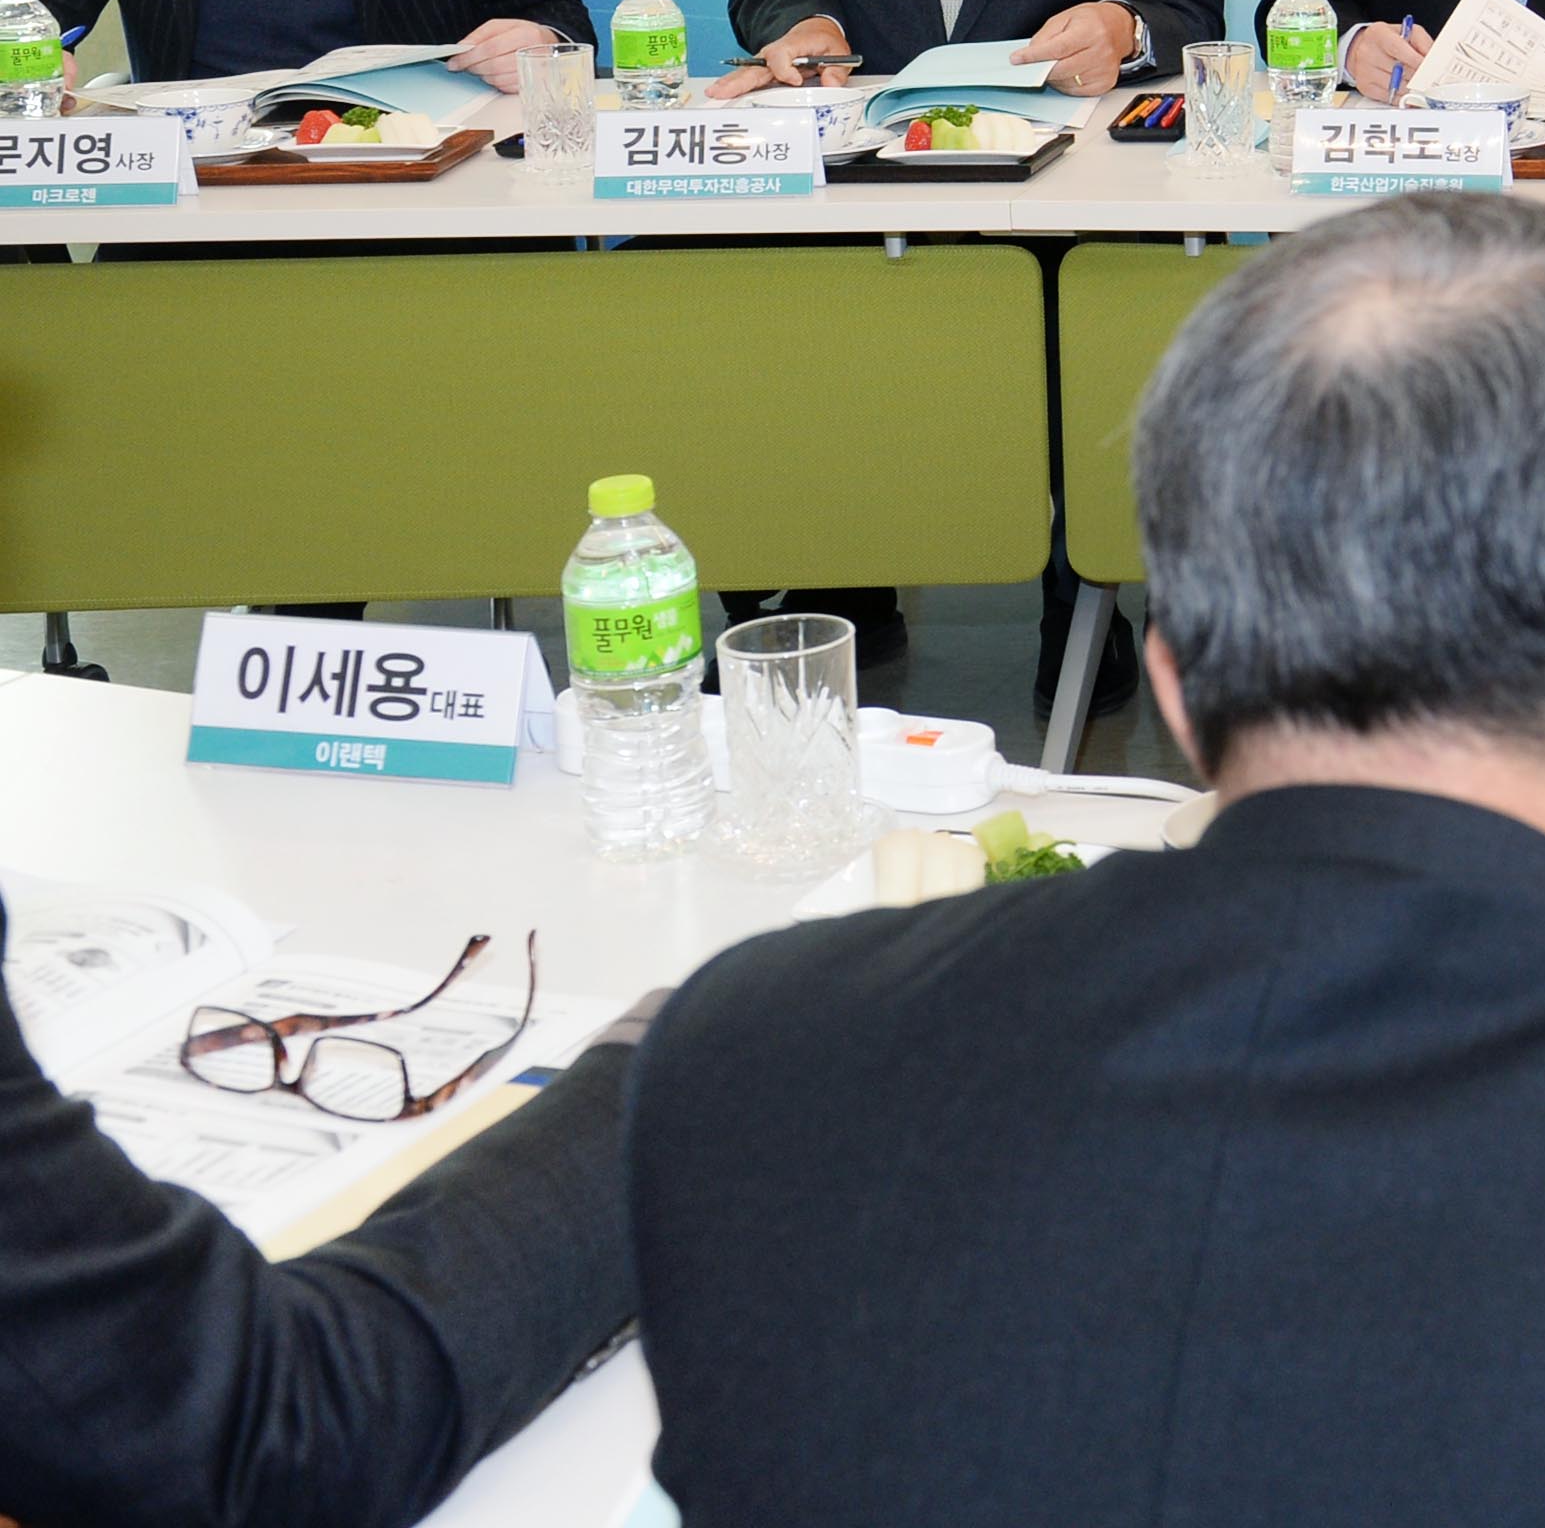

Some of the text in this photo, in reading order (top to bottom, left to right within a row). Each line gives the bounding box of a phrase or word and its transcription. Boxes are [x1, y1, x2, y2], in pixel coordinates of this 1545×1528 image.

[645, 33, 679, 57] 풀무원
[1320, 123, 1443, 165] 김학도
[115, 151, 155, 171] 사장
[31, 187, 97, 205] 마크로젠
[626, 176, 782, 196] 대한무역투자진흥공사
[591, 613, 654, 654] 풀무원
[237, 645, 486, 722] 이세용 대표
[314, 740, 388, 771] 이랜텍
